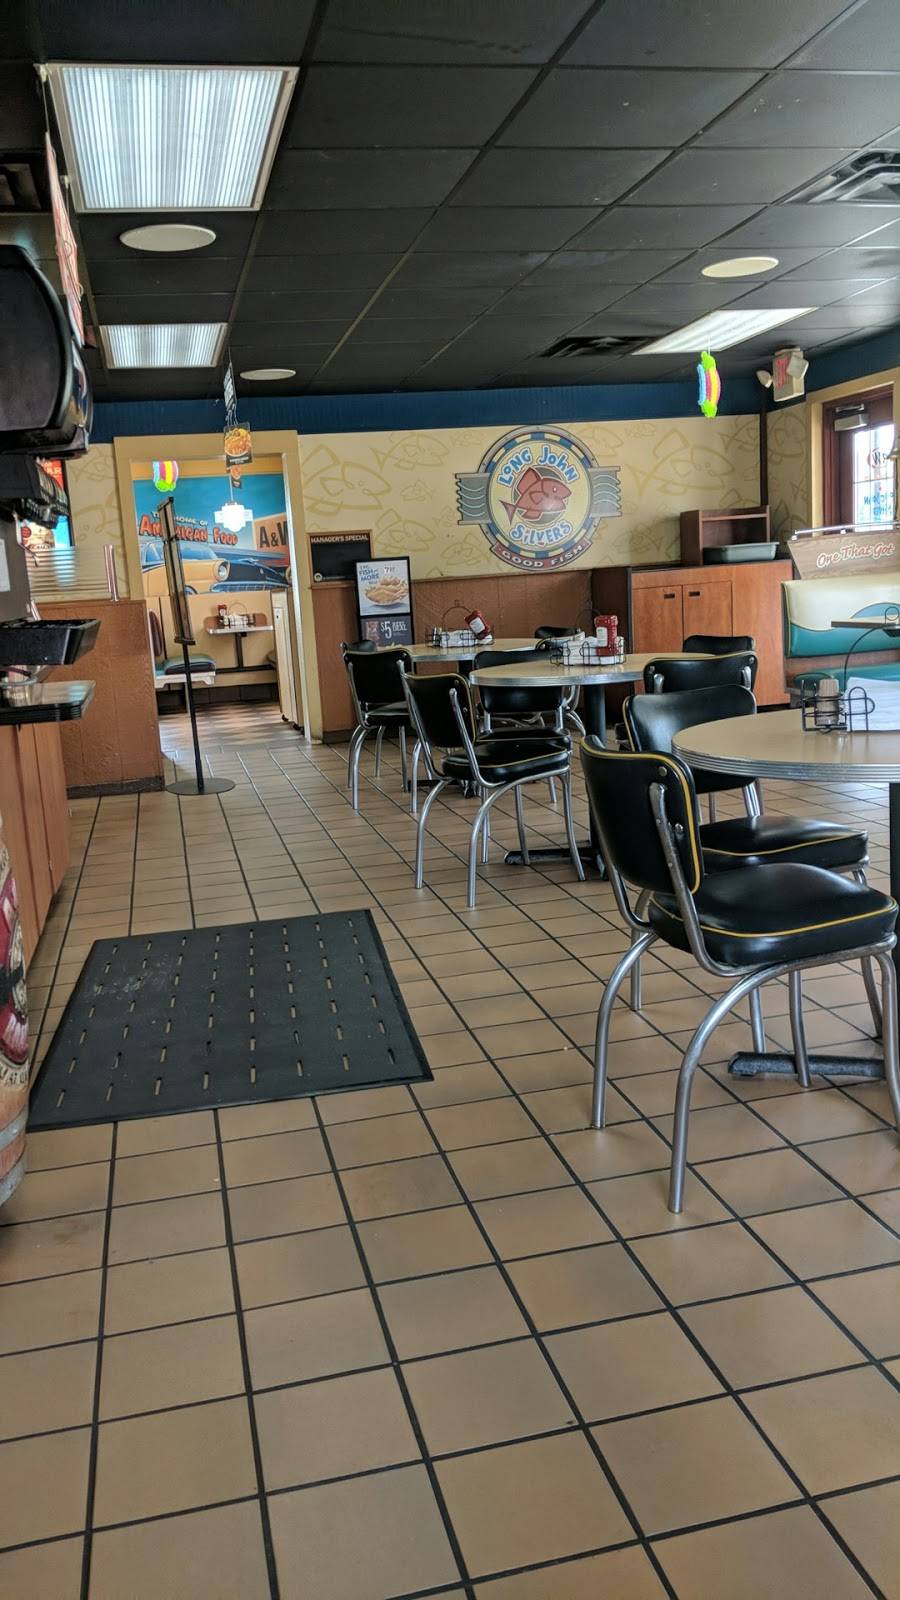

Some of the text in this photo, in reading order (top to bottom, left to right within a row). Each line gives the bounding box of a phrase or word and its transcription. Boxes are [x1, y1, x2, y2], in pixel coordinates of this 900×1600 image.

[502, 544, 584, 568] GOOD FISH
[816, 542, 896, 568] One That Got
[380, 621, 392, 639] $5
